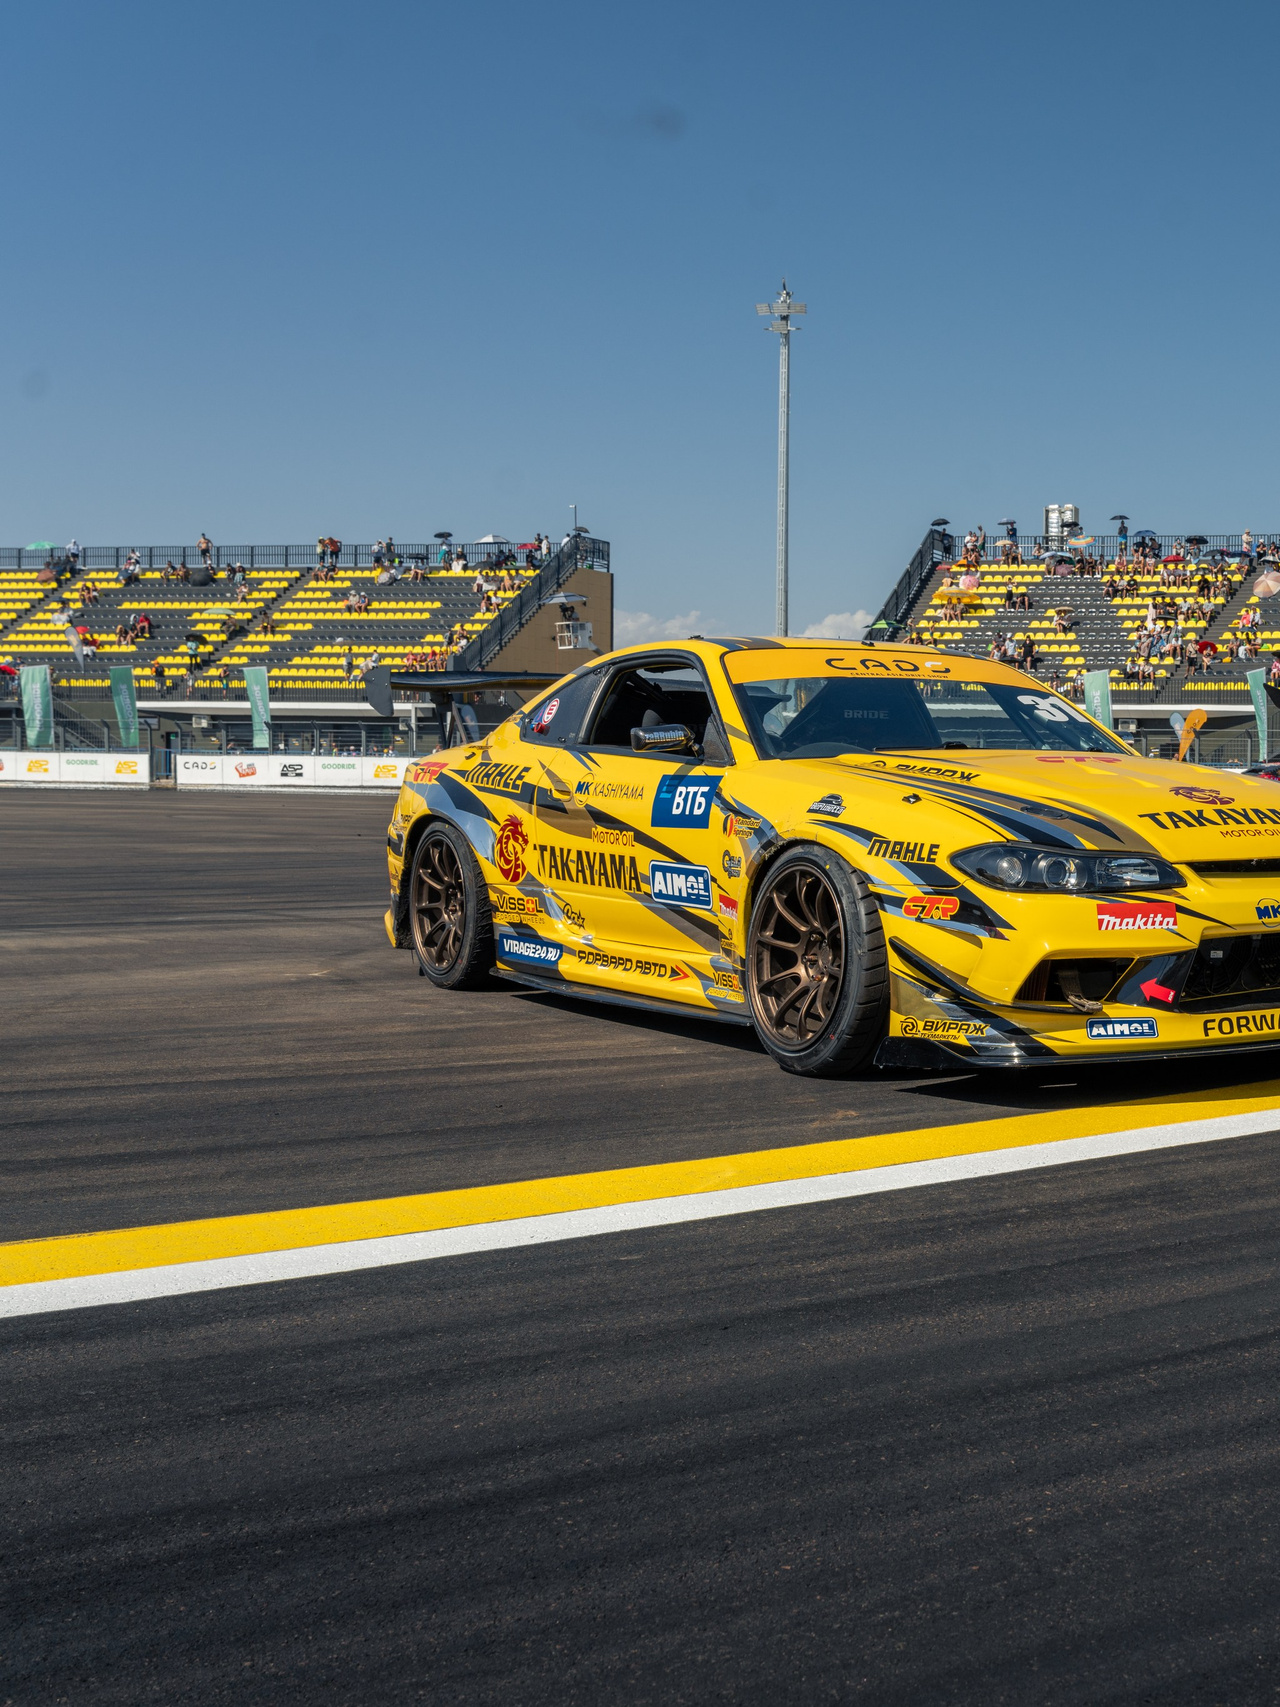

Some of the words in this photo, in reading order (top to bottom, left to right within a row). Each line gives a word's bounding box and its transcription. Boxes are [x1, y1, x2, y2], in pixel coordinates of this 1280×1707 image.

[825, 657, 951, 674] CADS
[843, 709, 890, 720] BRIDE
[183, 761, 217, 770] CADS
[465, 761, 532, 793] MAHLE
[575, 780, 593, 797] MK
[592, 781, 645, 801] KASHIYAMA
[672, 786, 710, 815] ВТБ
[592, 830, 621, 846] MOTOR
[621, 832, 635, 848] OIL
[1219, 829, 1259, 839] MOTOR
[867, 838, 940, 863] MAHLE
[533, 844, 643, 892] TAKAYAMA
[653, 871, 709, 899] AIMOL
[922, 1020, 990, 1036] ВИРАЖ
[1091, 1022, 1154, 1036] AIMOL
